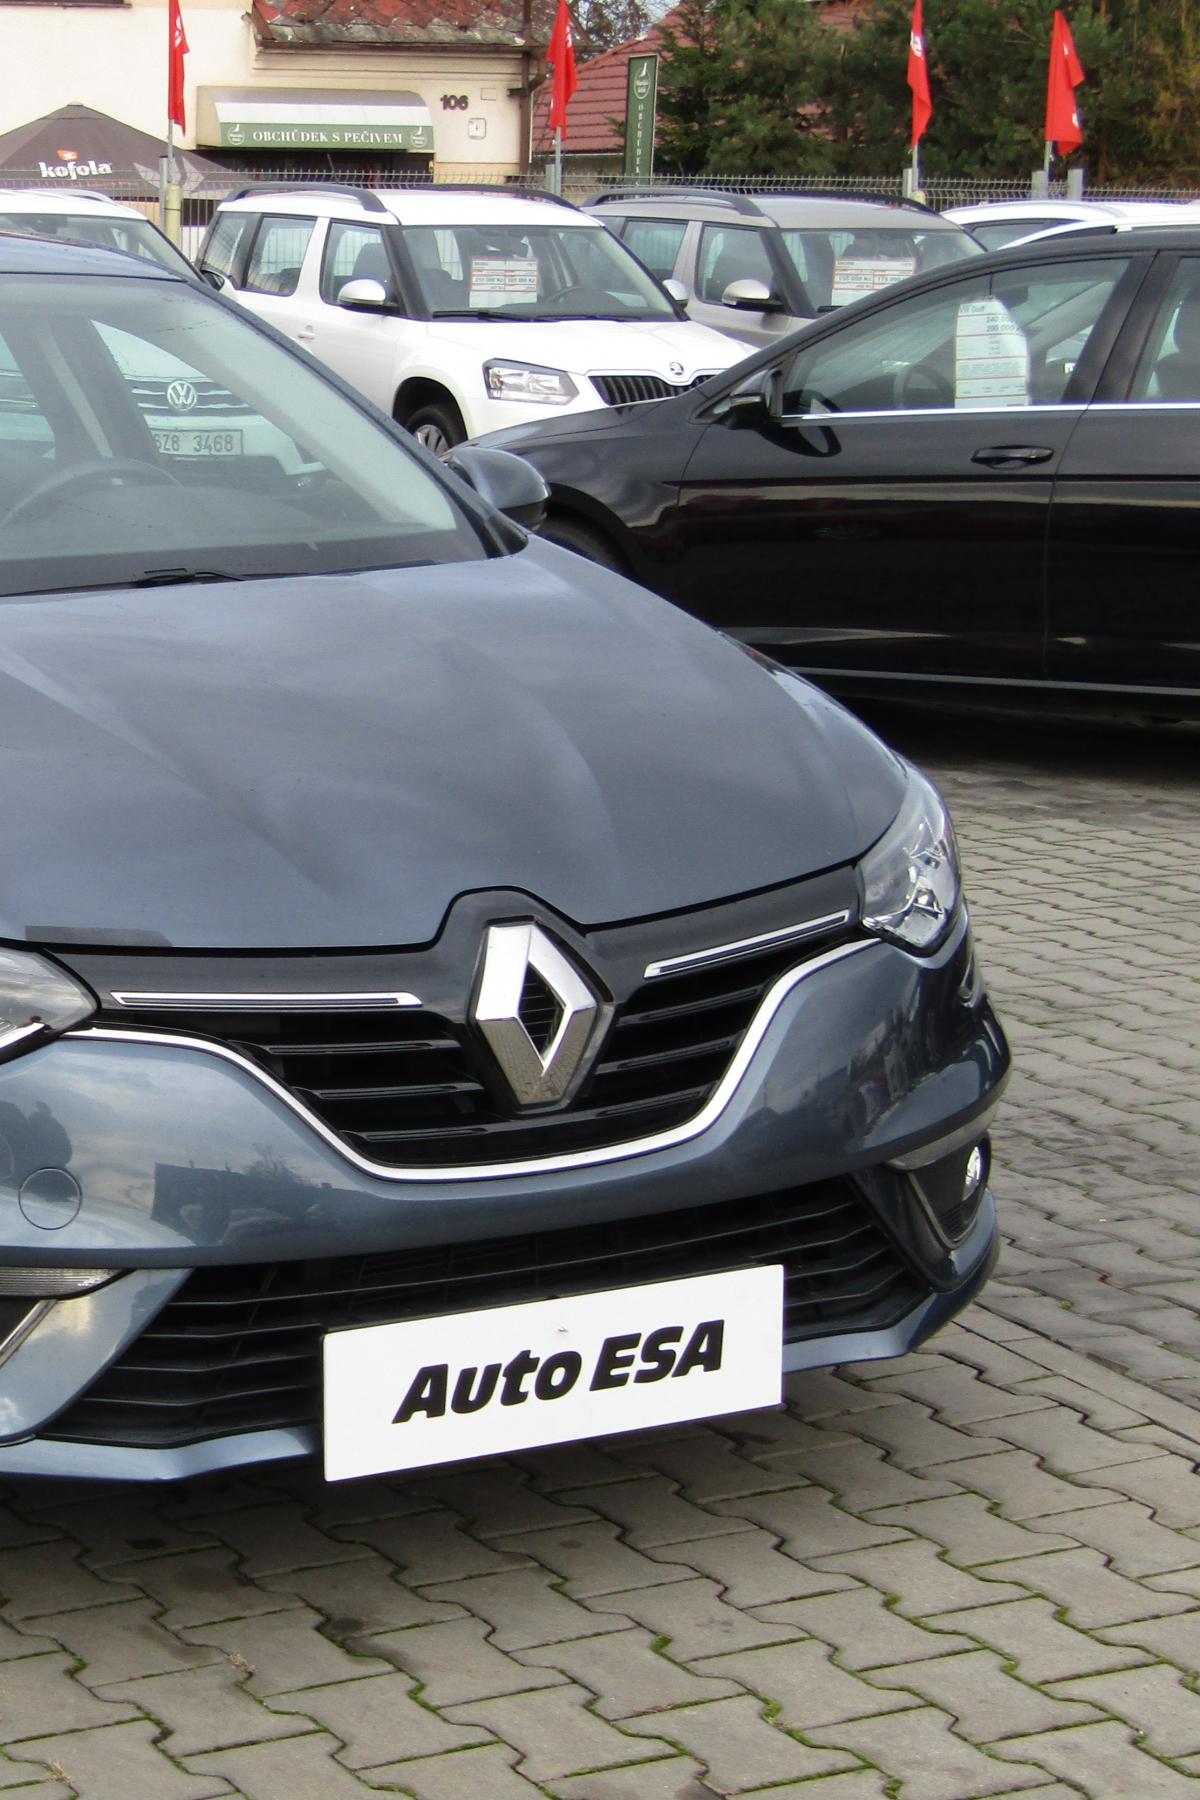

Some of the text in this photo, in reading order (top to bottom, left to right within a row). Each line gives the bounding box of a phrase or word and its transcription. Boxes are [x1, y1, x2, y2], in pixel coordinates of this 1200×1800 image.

[440, 94, 469, 111] 106
[252, 129, 329, 143] OBCHŮDEK
[332, 131, 341, 143] S
[344, 130, 403, 144] PEČIVEM
[39, 160, 113, 180] kofola
[193, 434, 234, 452] 3468
[392, 1319, 725, 1424] Auto ESA
